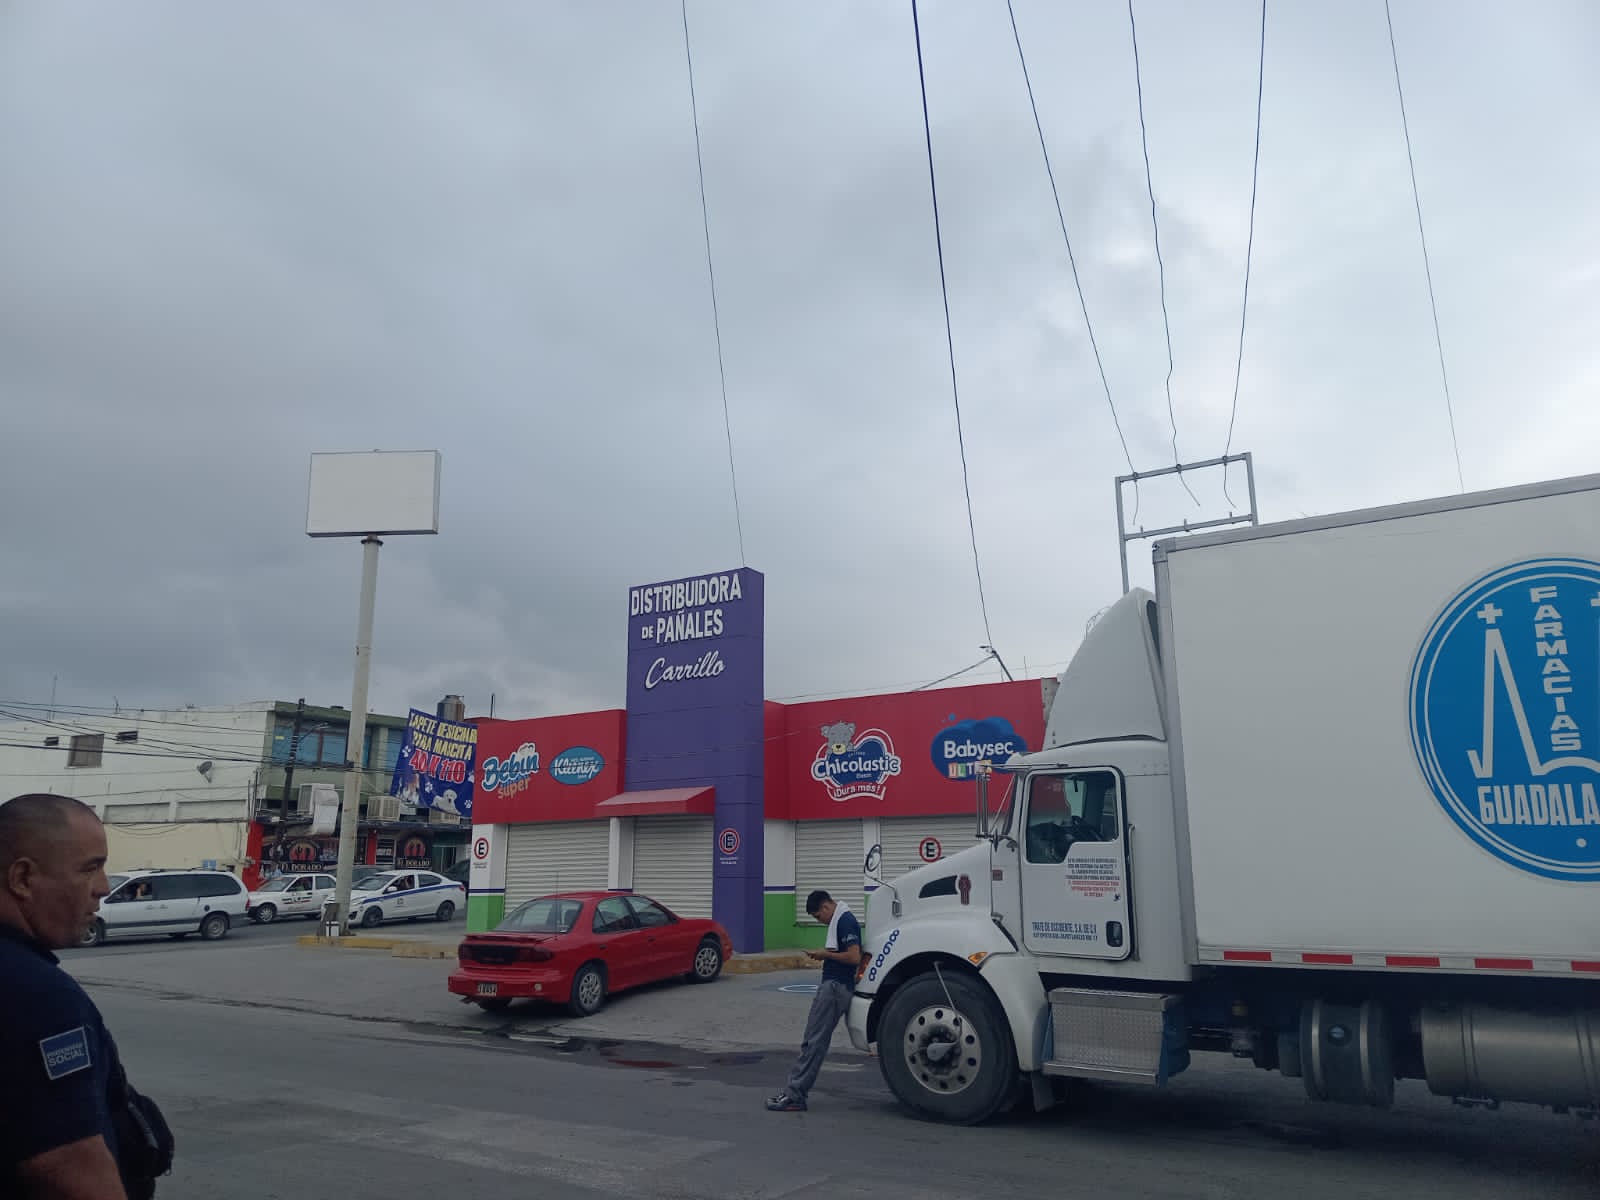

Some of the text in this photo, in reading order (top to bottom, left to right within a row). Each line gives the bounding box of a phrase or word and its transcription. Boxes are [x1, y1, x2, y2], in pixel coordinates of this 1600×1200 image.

[631, 573, 742, 616] DISTRIBUIDORA
[641, 608, 723, 644] DE PAÑALES
[645, 650, 726, 689] Carrillo
[1529, 585, 1583, 752] FARMACIAS
[943, 739, 1014, 760] Babysec
[409, 748, 429, 774] 40
[439, 759, 466, 784] 110
[813, 752, 901, 780] Chicolastic
[948, 759, 993, 779] ULT
[497, 777, 531, 800] super
[1477, 783, 1600, 826] GUADALA
[478, 842, 485, 855] E
[925, 842, 935, 857] E
[48, 1048, 86, 1067] SOCIAL
